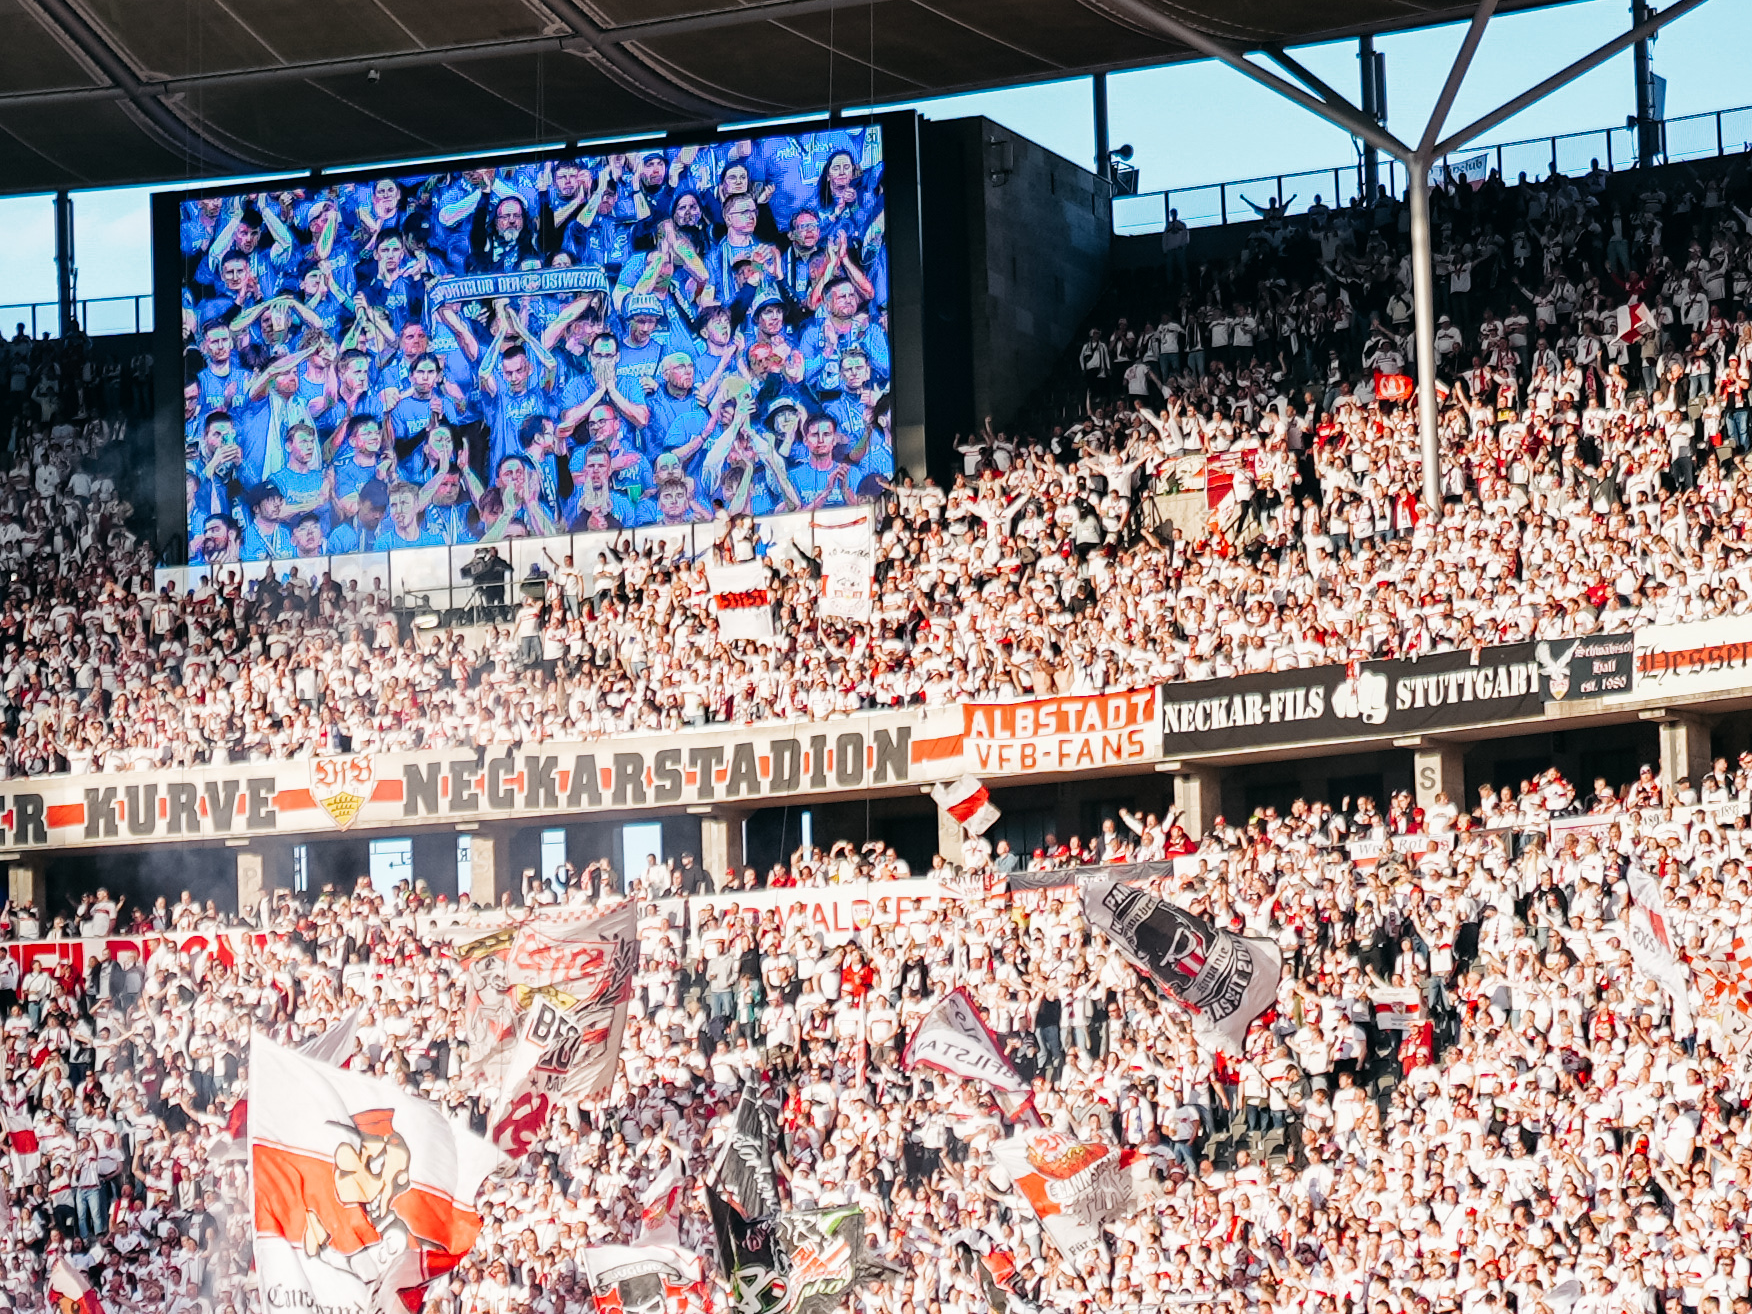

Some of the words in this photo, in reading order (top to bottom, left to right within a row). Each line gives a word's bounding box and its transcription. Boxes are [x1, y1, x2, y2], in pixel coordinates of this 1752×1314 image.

[433, 277, 495, 301] SPORTCLUB
[497, 275, 520, 296] DER
[969, 692, 1155, 740] ALBSTADT
[1163, 685, 1326, 735] NECKAR-FILS
[1395, 662, 1540, 711] STUTTGART
[976, 727, 1145, 771] VFB-FANS
[83, 777, 277, 840] KURVE
[402, 726, 913, 819] NECKARSTADION
[1417, 765, 1437, 793] S
